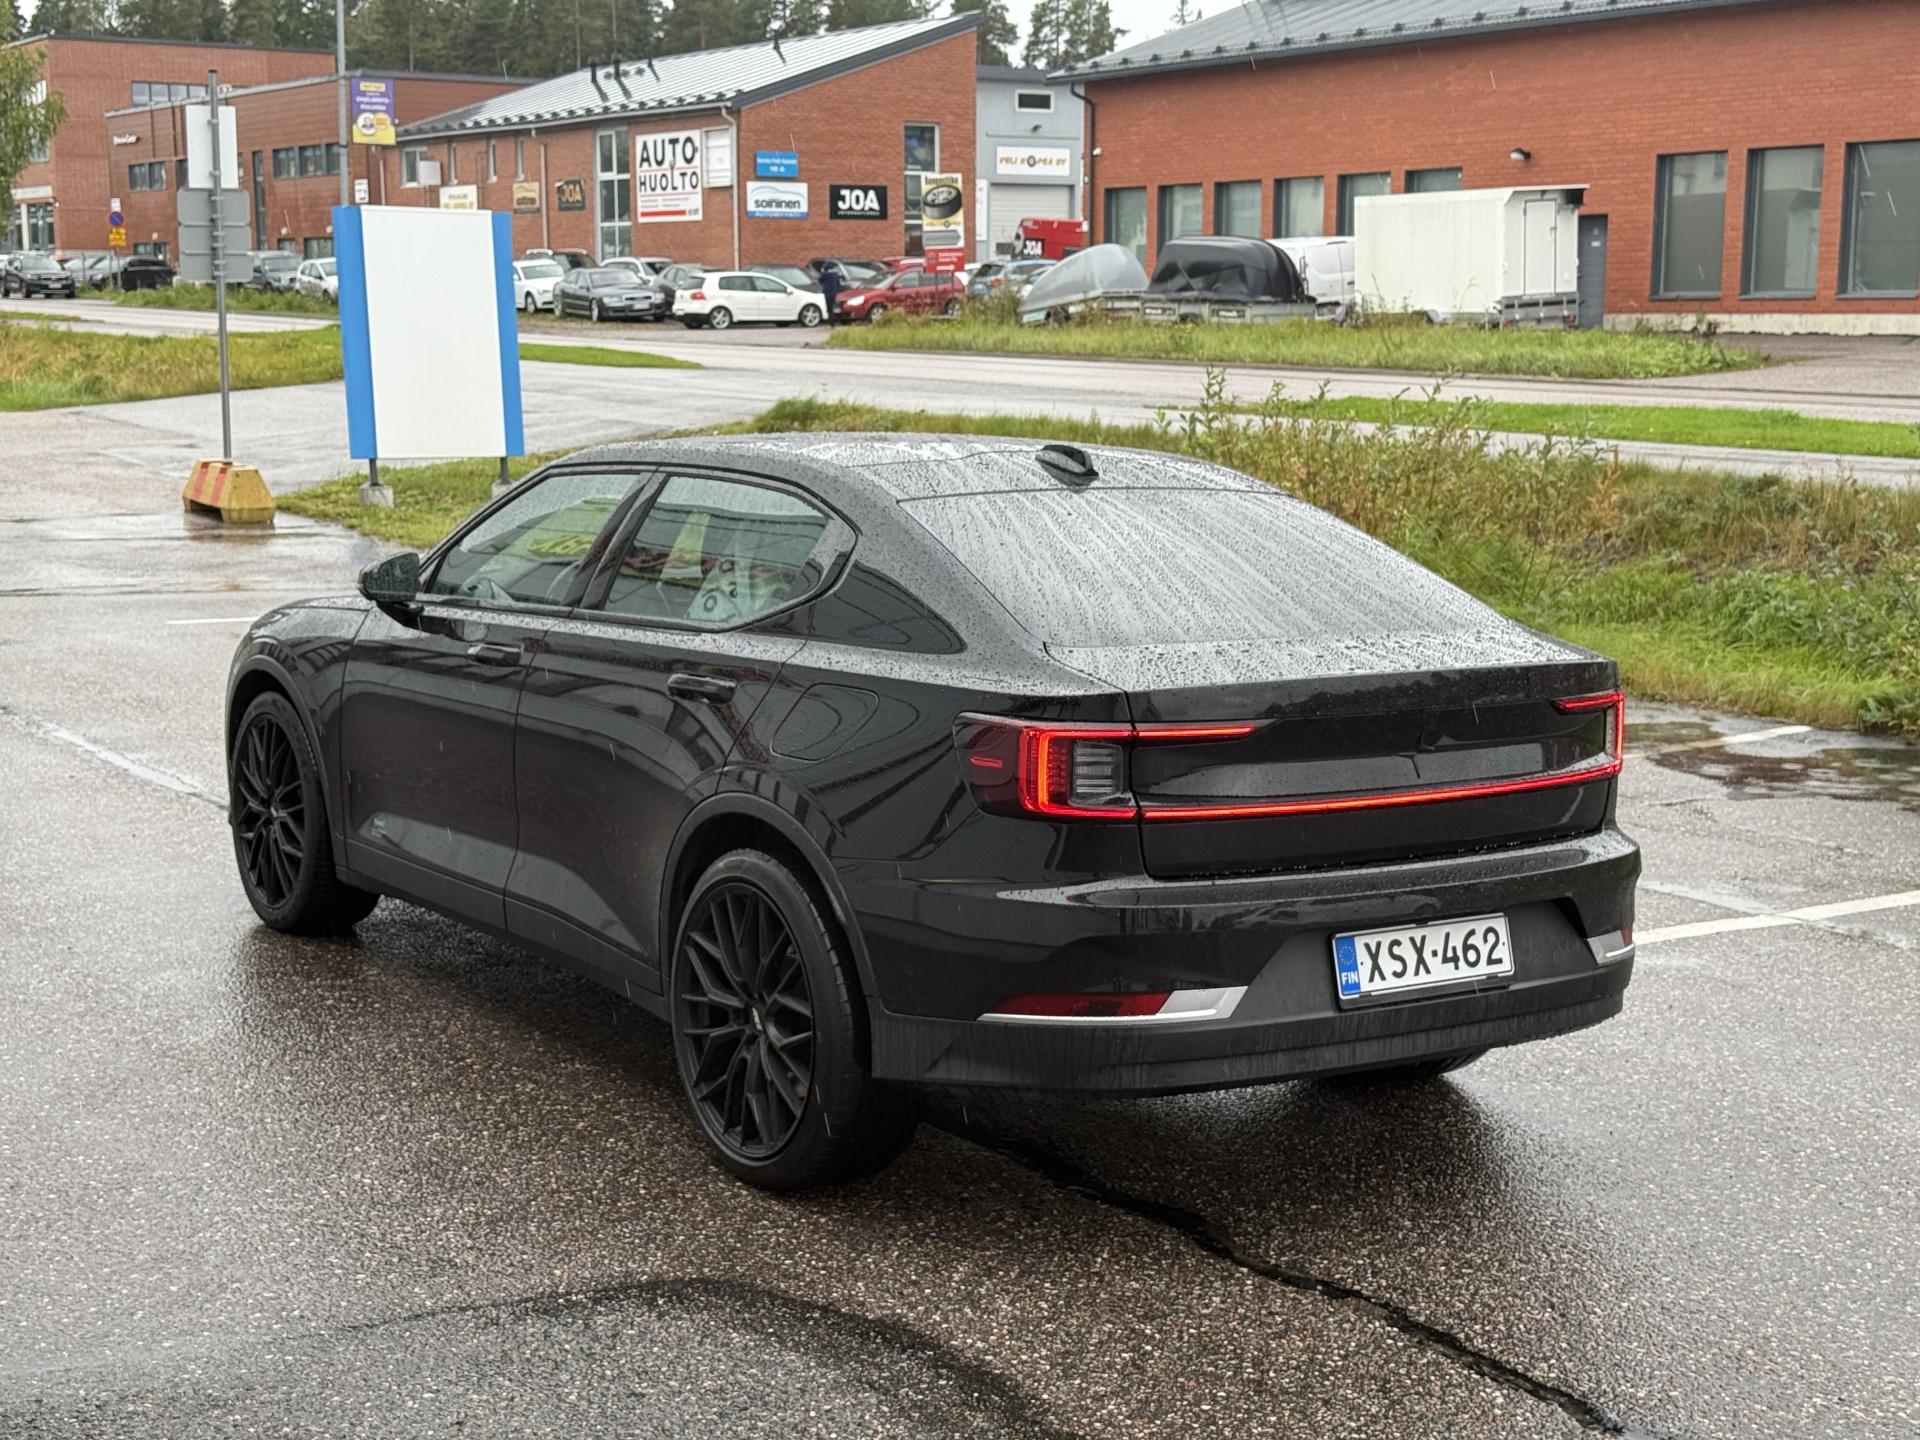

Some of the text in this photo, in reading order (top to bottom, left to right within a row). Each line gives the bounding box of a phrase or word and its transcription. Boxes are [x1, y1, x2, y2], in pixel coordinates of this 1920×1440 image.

[639, 170, 699, 193] HUOLTO
[837, 188, 881, 211] JOA
[1363, 925, 1504, 983] XSX-462
[1341, 970, 1359, 986] FIN
